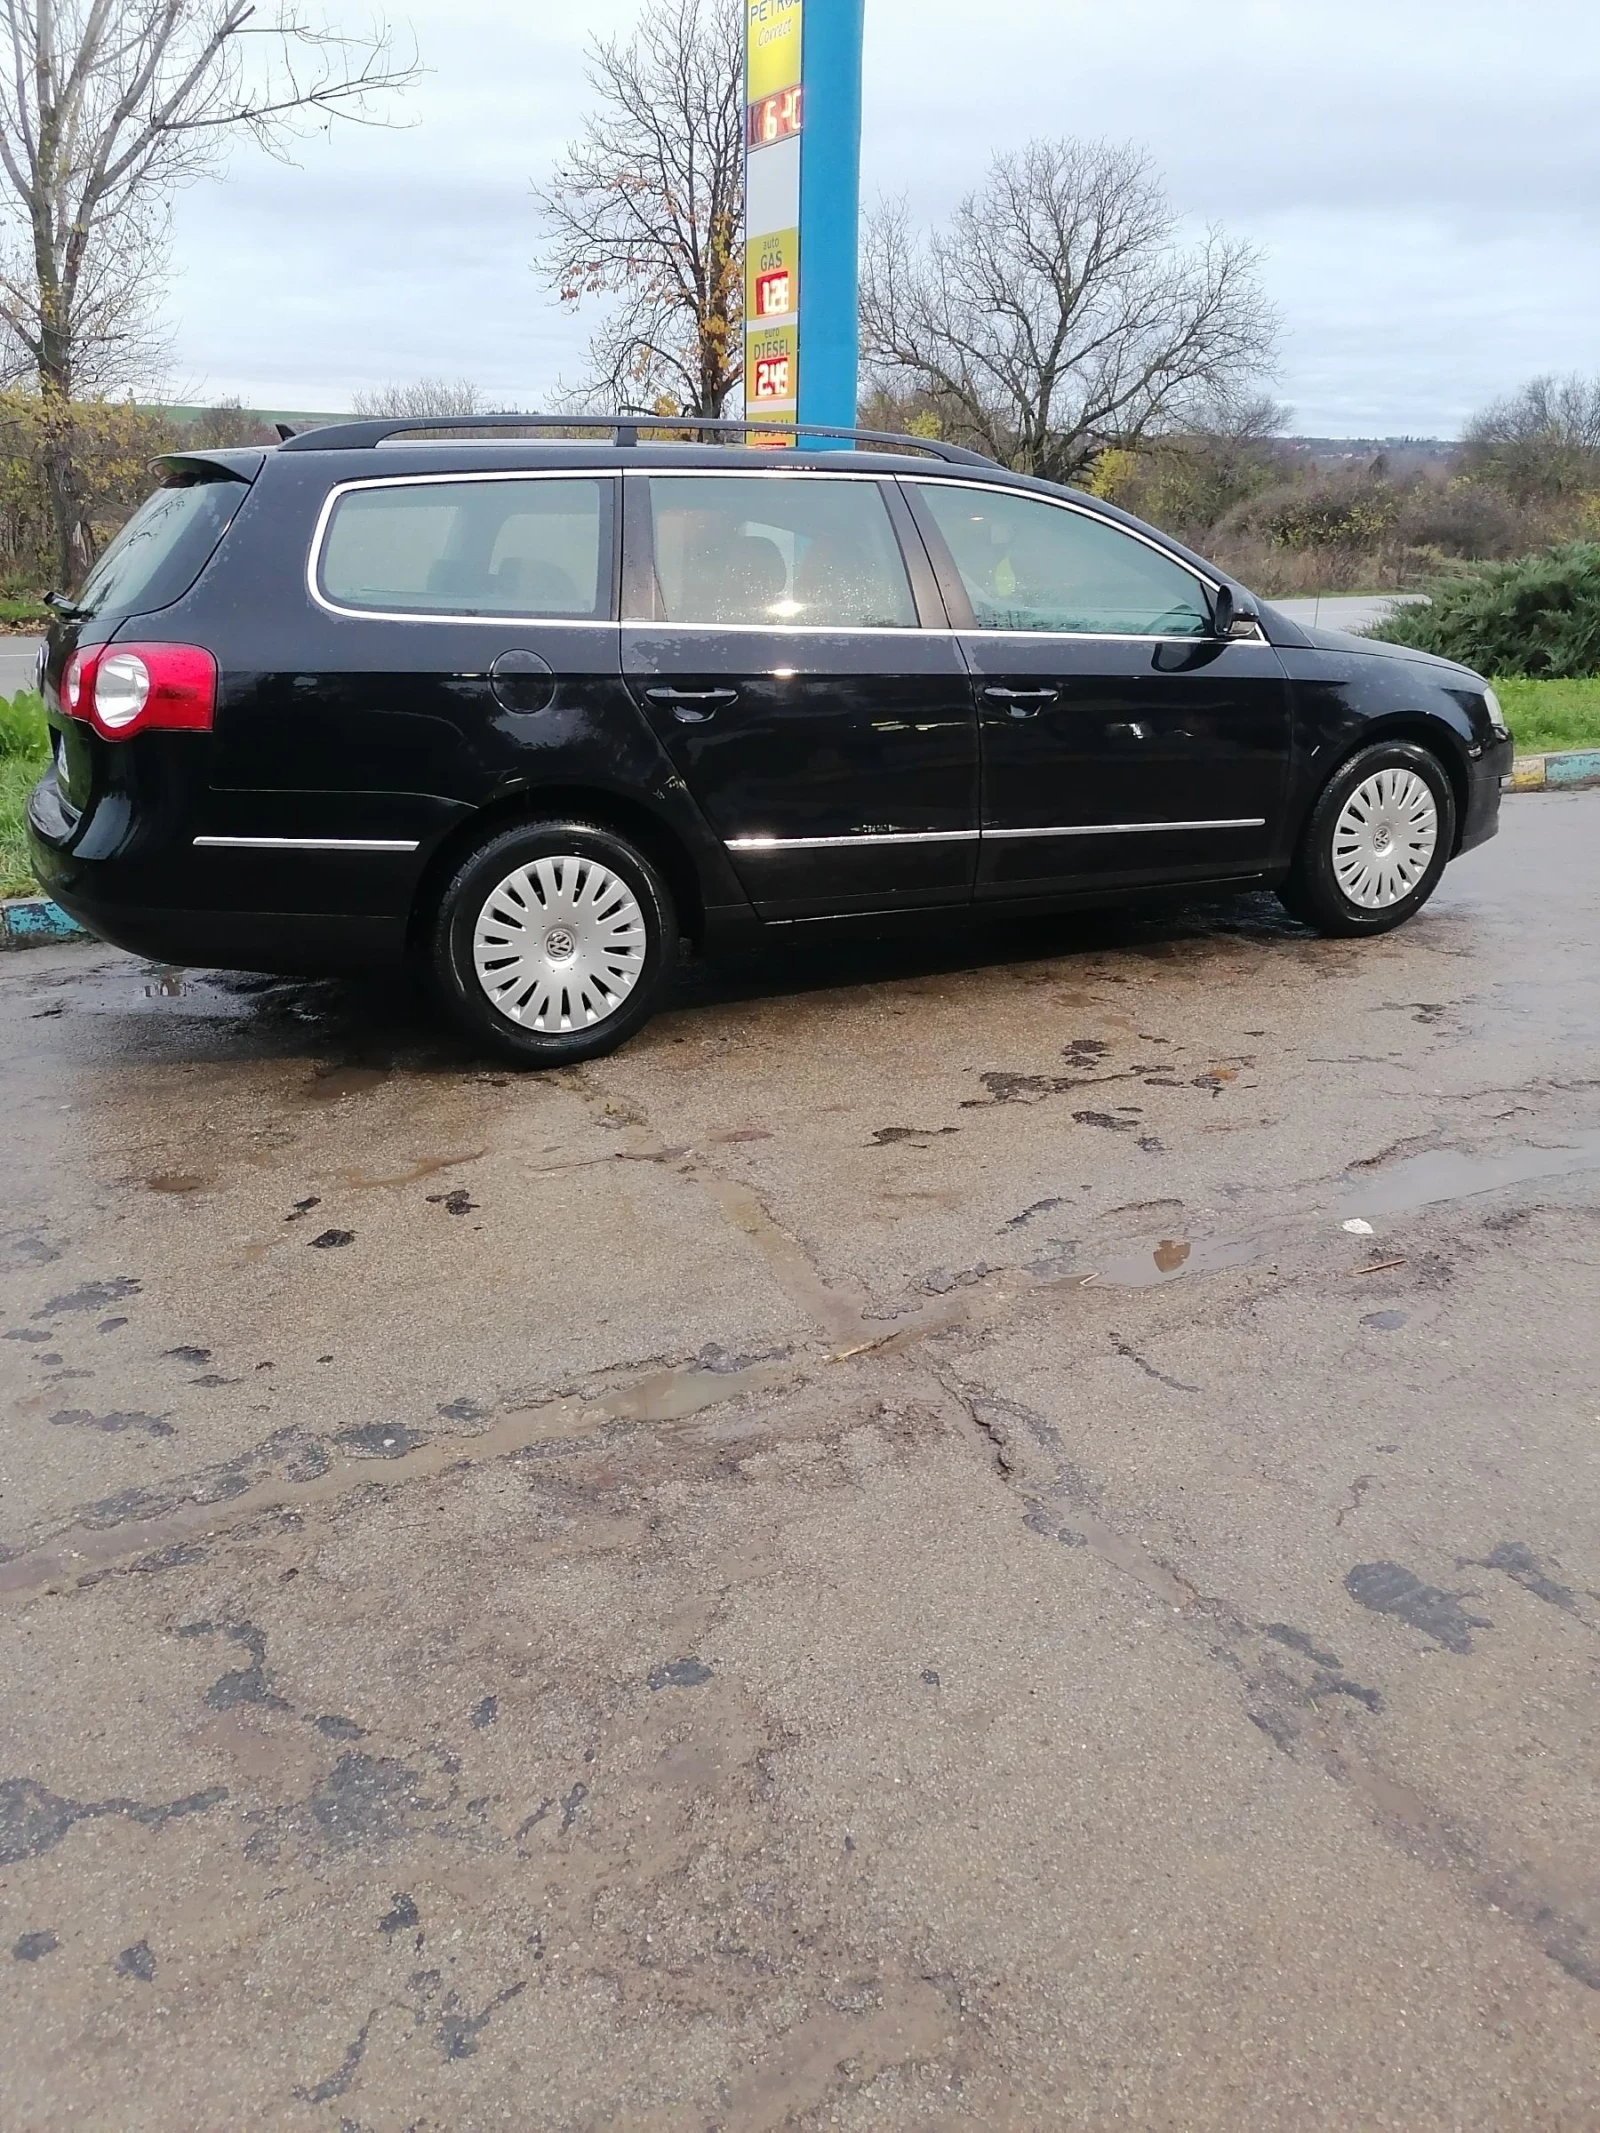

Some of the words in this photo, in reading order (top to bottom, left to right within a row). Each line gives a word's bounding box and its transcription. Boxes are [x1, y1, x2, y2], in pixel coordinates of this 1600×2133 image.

[750, 0, 801, 26] PETR
[763, 238, 780, 250] auto
[760, 250, 783, 272] GAS
[764, 327, 780, 338] euro
[754, 339, 791, 360] DIESEL
